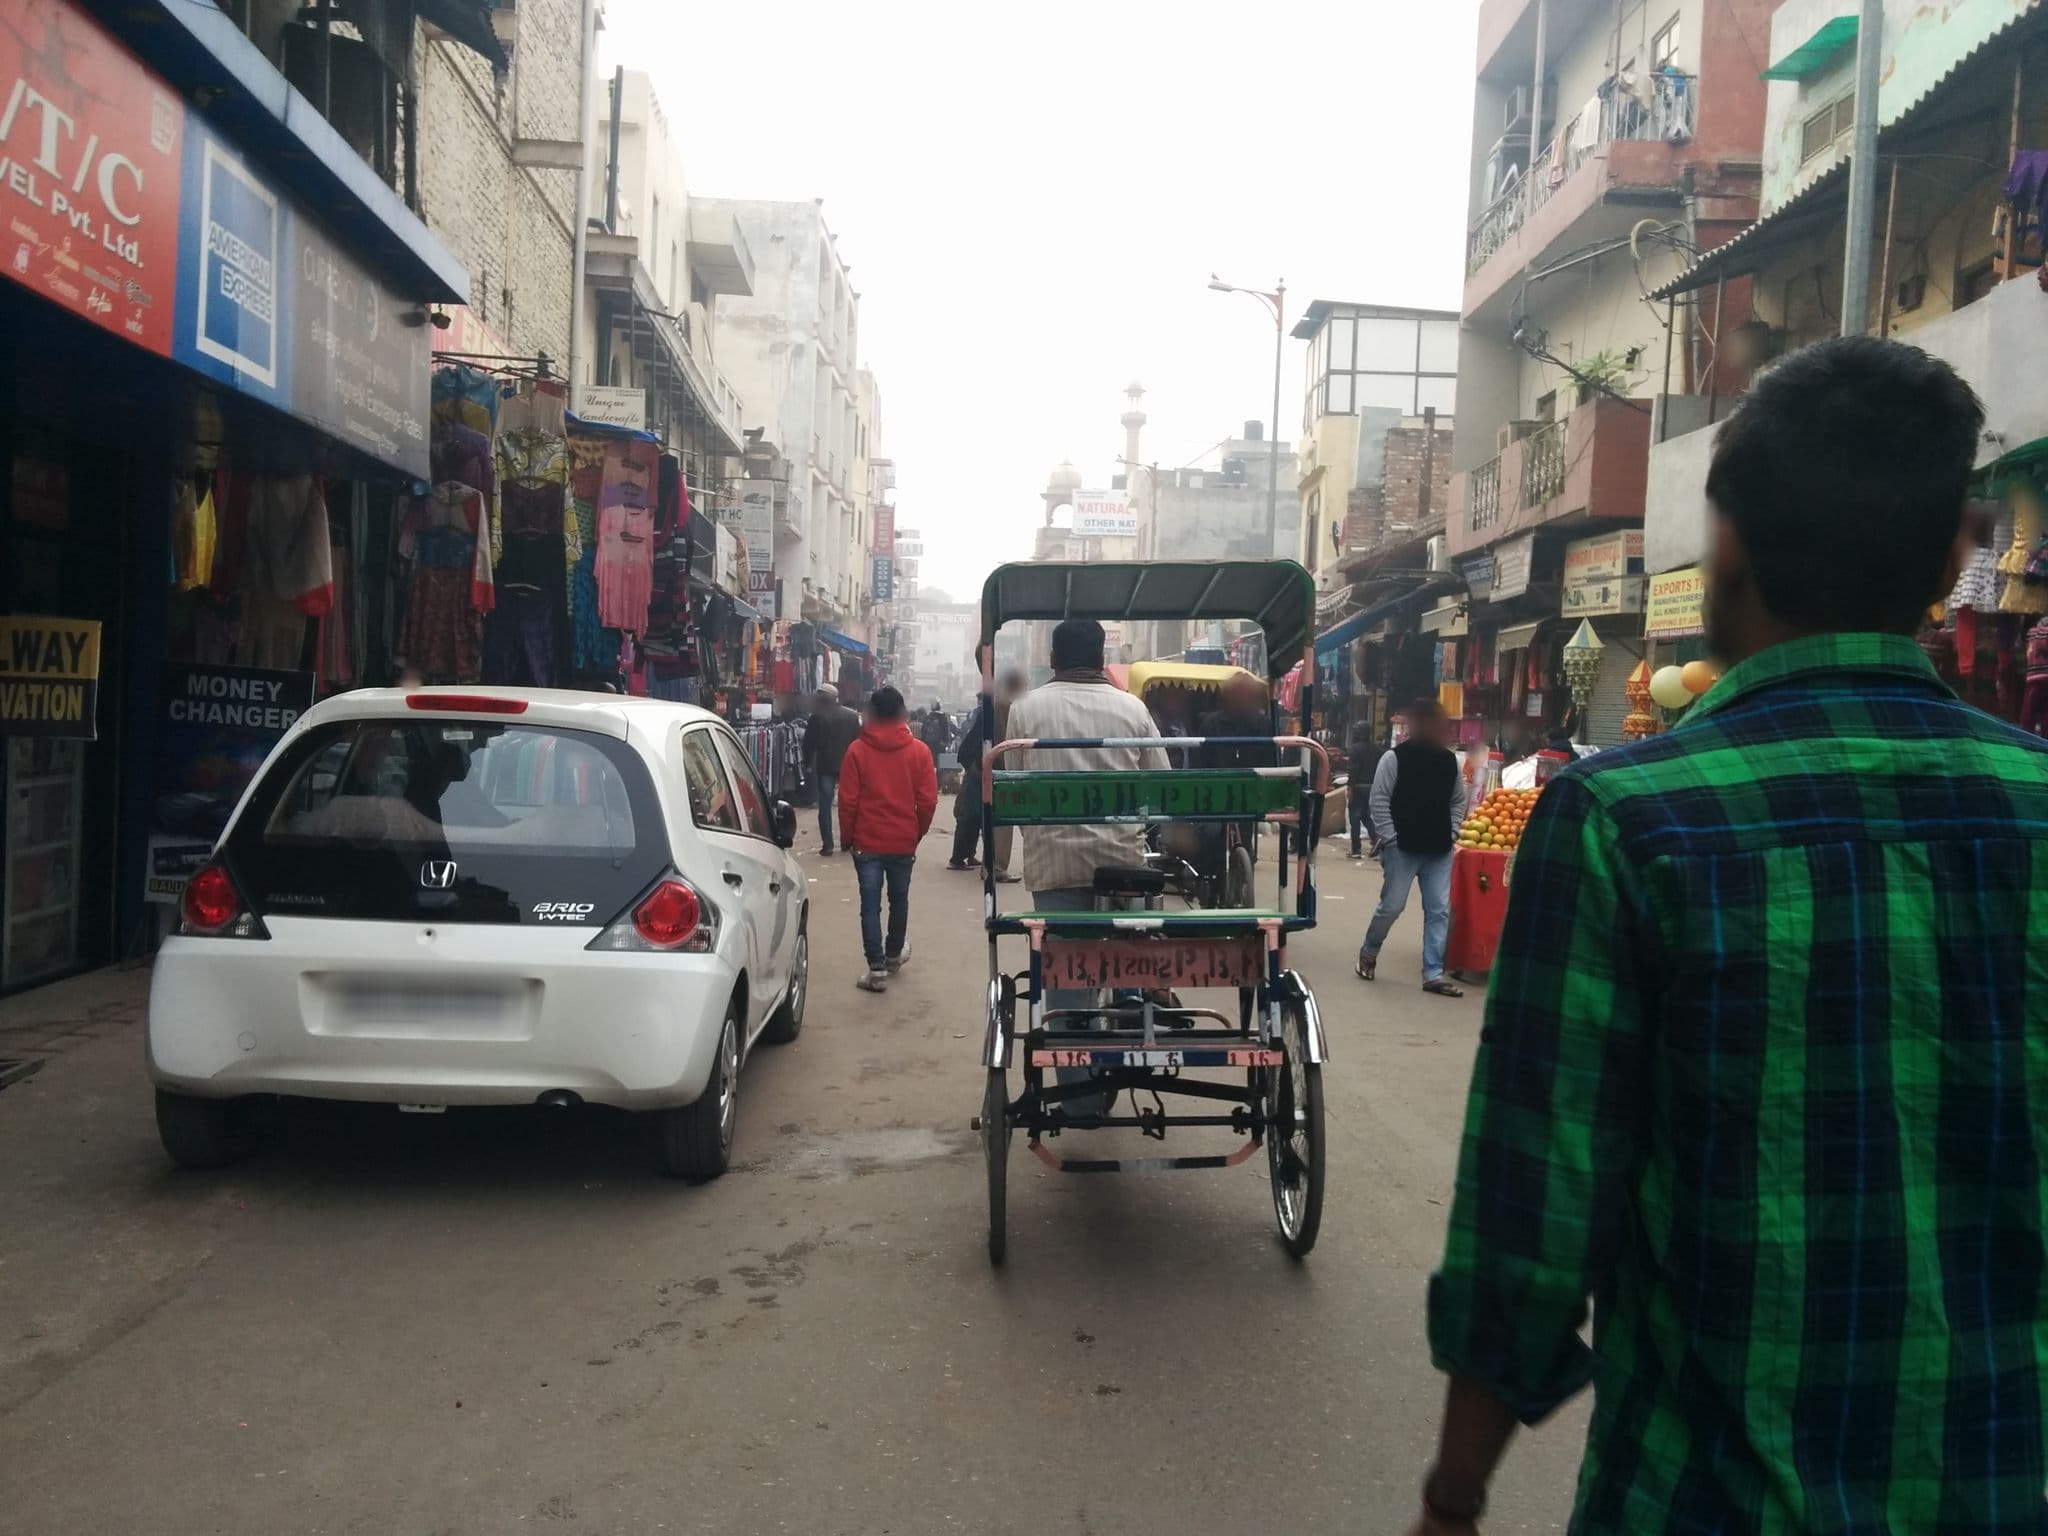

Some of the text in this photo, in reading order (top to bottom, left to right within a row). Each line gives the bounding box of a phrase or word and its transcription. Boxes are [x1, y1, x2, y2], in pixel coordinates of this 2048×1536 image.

[52, 190, 96, 240] Pvt.
[103, 223, 145, 268] Ltd.
[208, 221, 271, 290] AMERICAN
[221, 264, 272, 323] EXPRESS
[1653, 579, 1692, 597] EXPORTS
[0, 630, 89, 673] WAY
[187, 674, 283, 702] MONEY
[168, 699, 298, 729] CHANGER
[531, 902, 595, 913] BRIO
